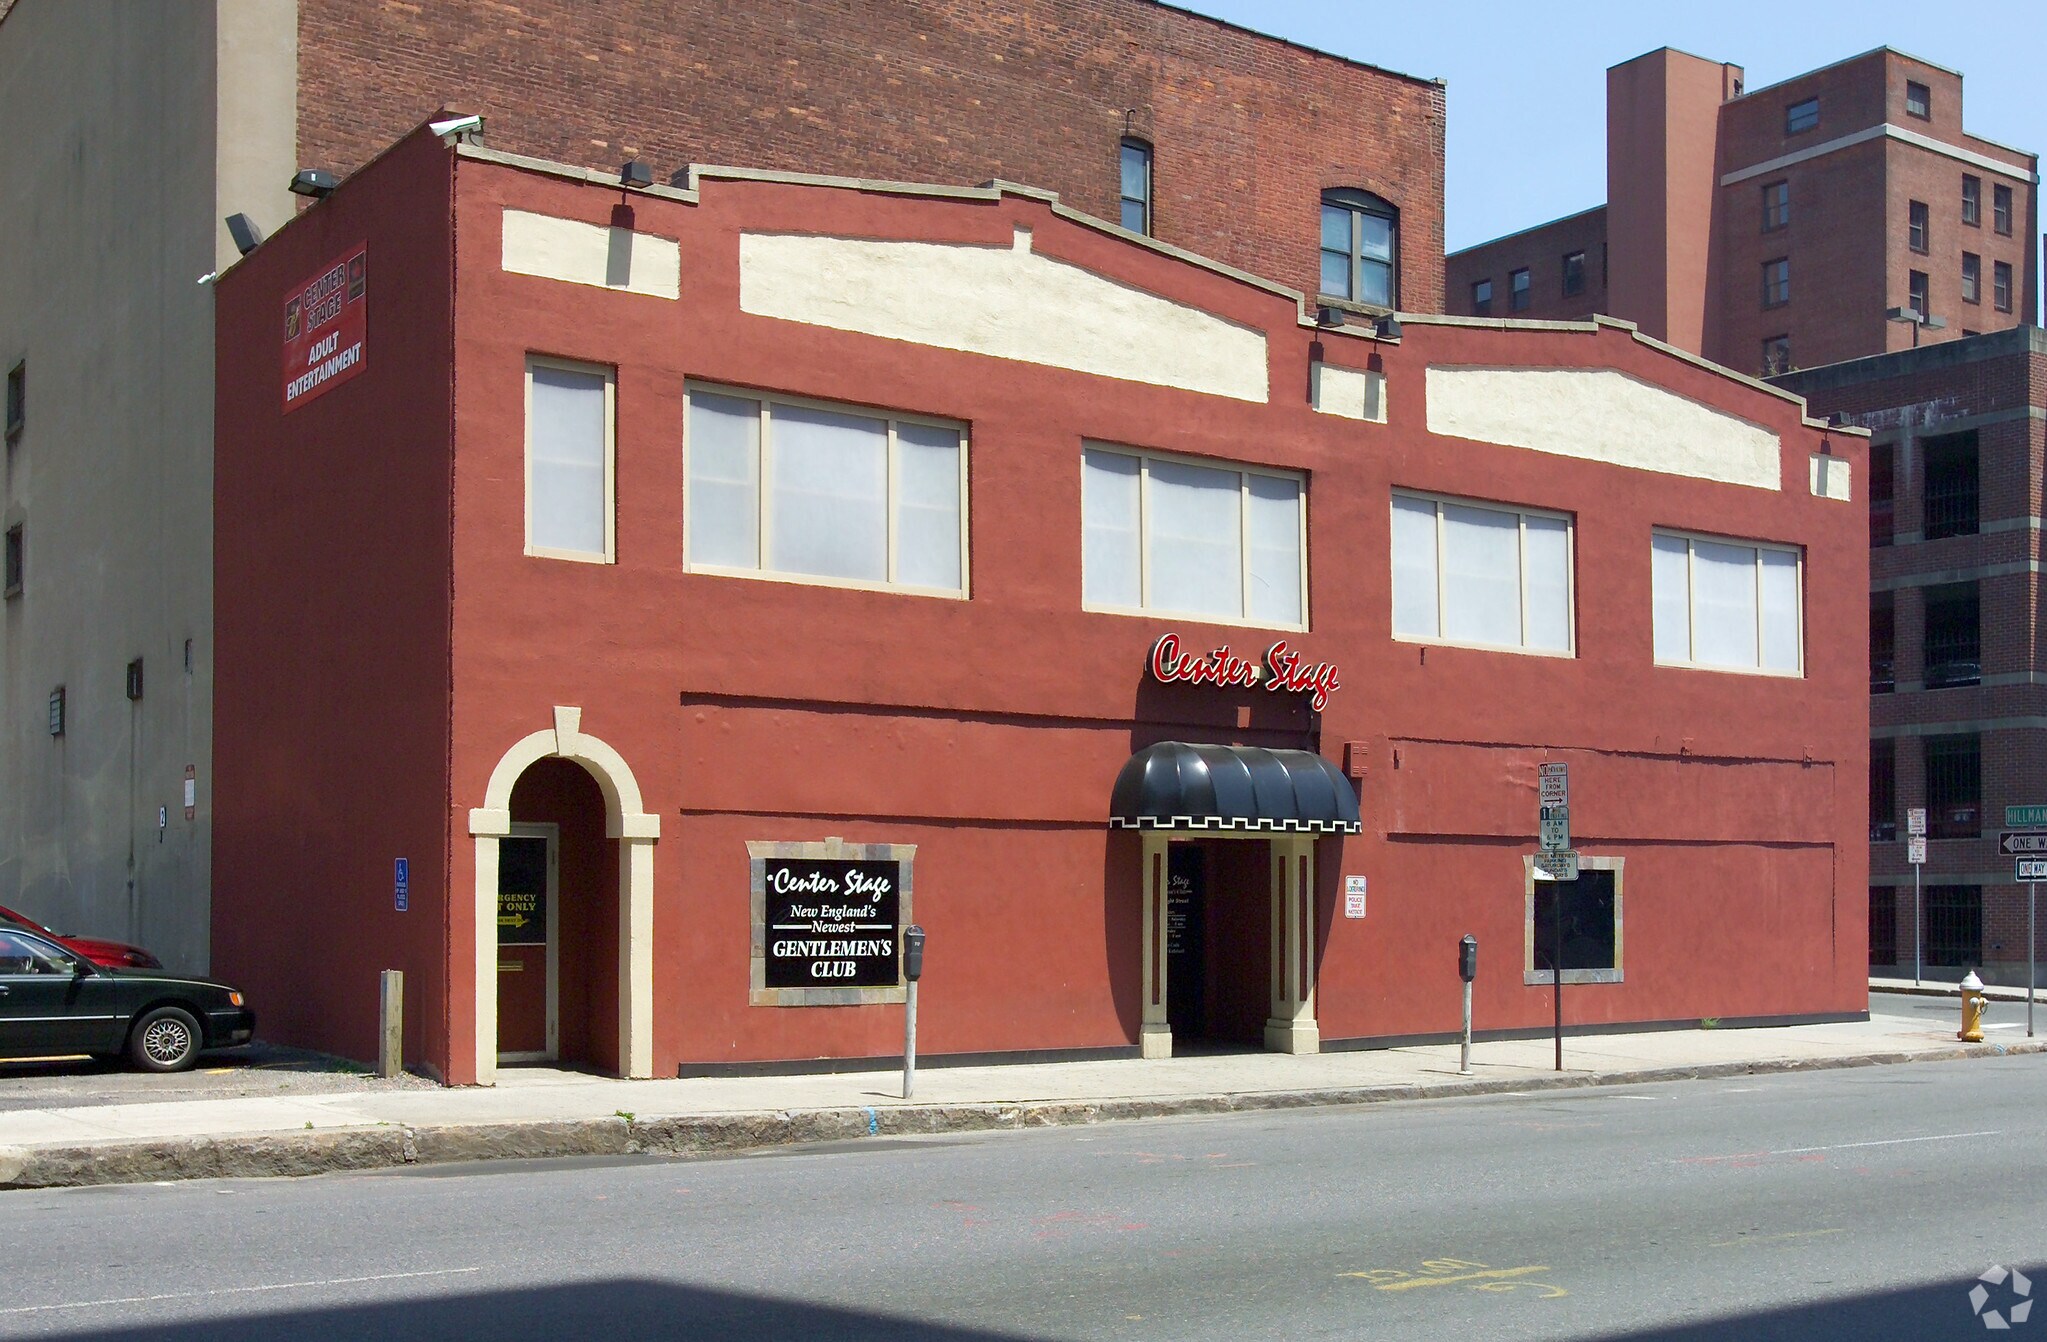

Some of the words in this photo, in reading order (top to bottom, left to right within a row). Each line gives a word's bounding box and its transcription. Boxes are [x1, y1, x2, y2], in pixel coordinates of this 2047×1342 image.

[304, 263, 346, 310] CENTER
[307, 291, 341, 333] STAGE
[308, 331, 339, 366] ADULT
[287, 342, 362, 402] ENTERTAINMENT
[1153, 633, 1257, 687] Center
[1265, 640, 1340, 711] Stage
[2013, 838, 2031, 848] ONE
[2038, 838, 2047, 848] W
[2020, 863, 2031, 874] ONE
[2034, 863, 2045, 873] WAY
[774, 867, 840, 894] Center
[844, 869, 891, 902] Stage
[498, 894, 536, 902] RGENCY
[506, 902, 536, 911] ONLY
[790, 905, 818, 917] New
[821, 905, 876, 921] England's
[811, 921, 856, 933] Newest
[773, 939, 892, 957] GENTLEMEN'S
[811, 961, 856, 977] CLUB
